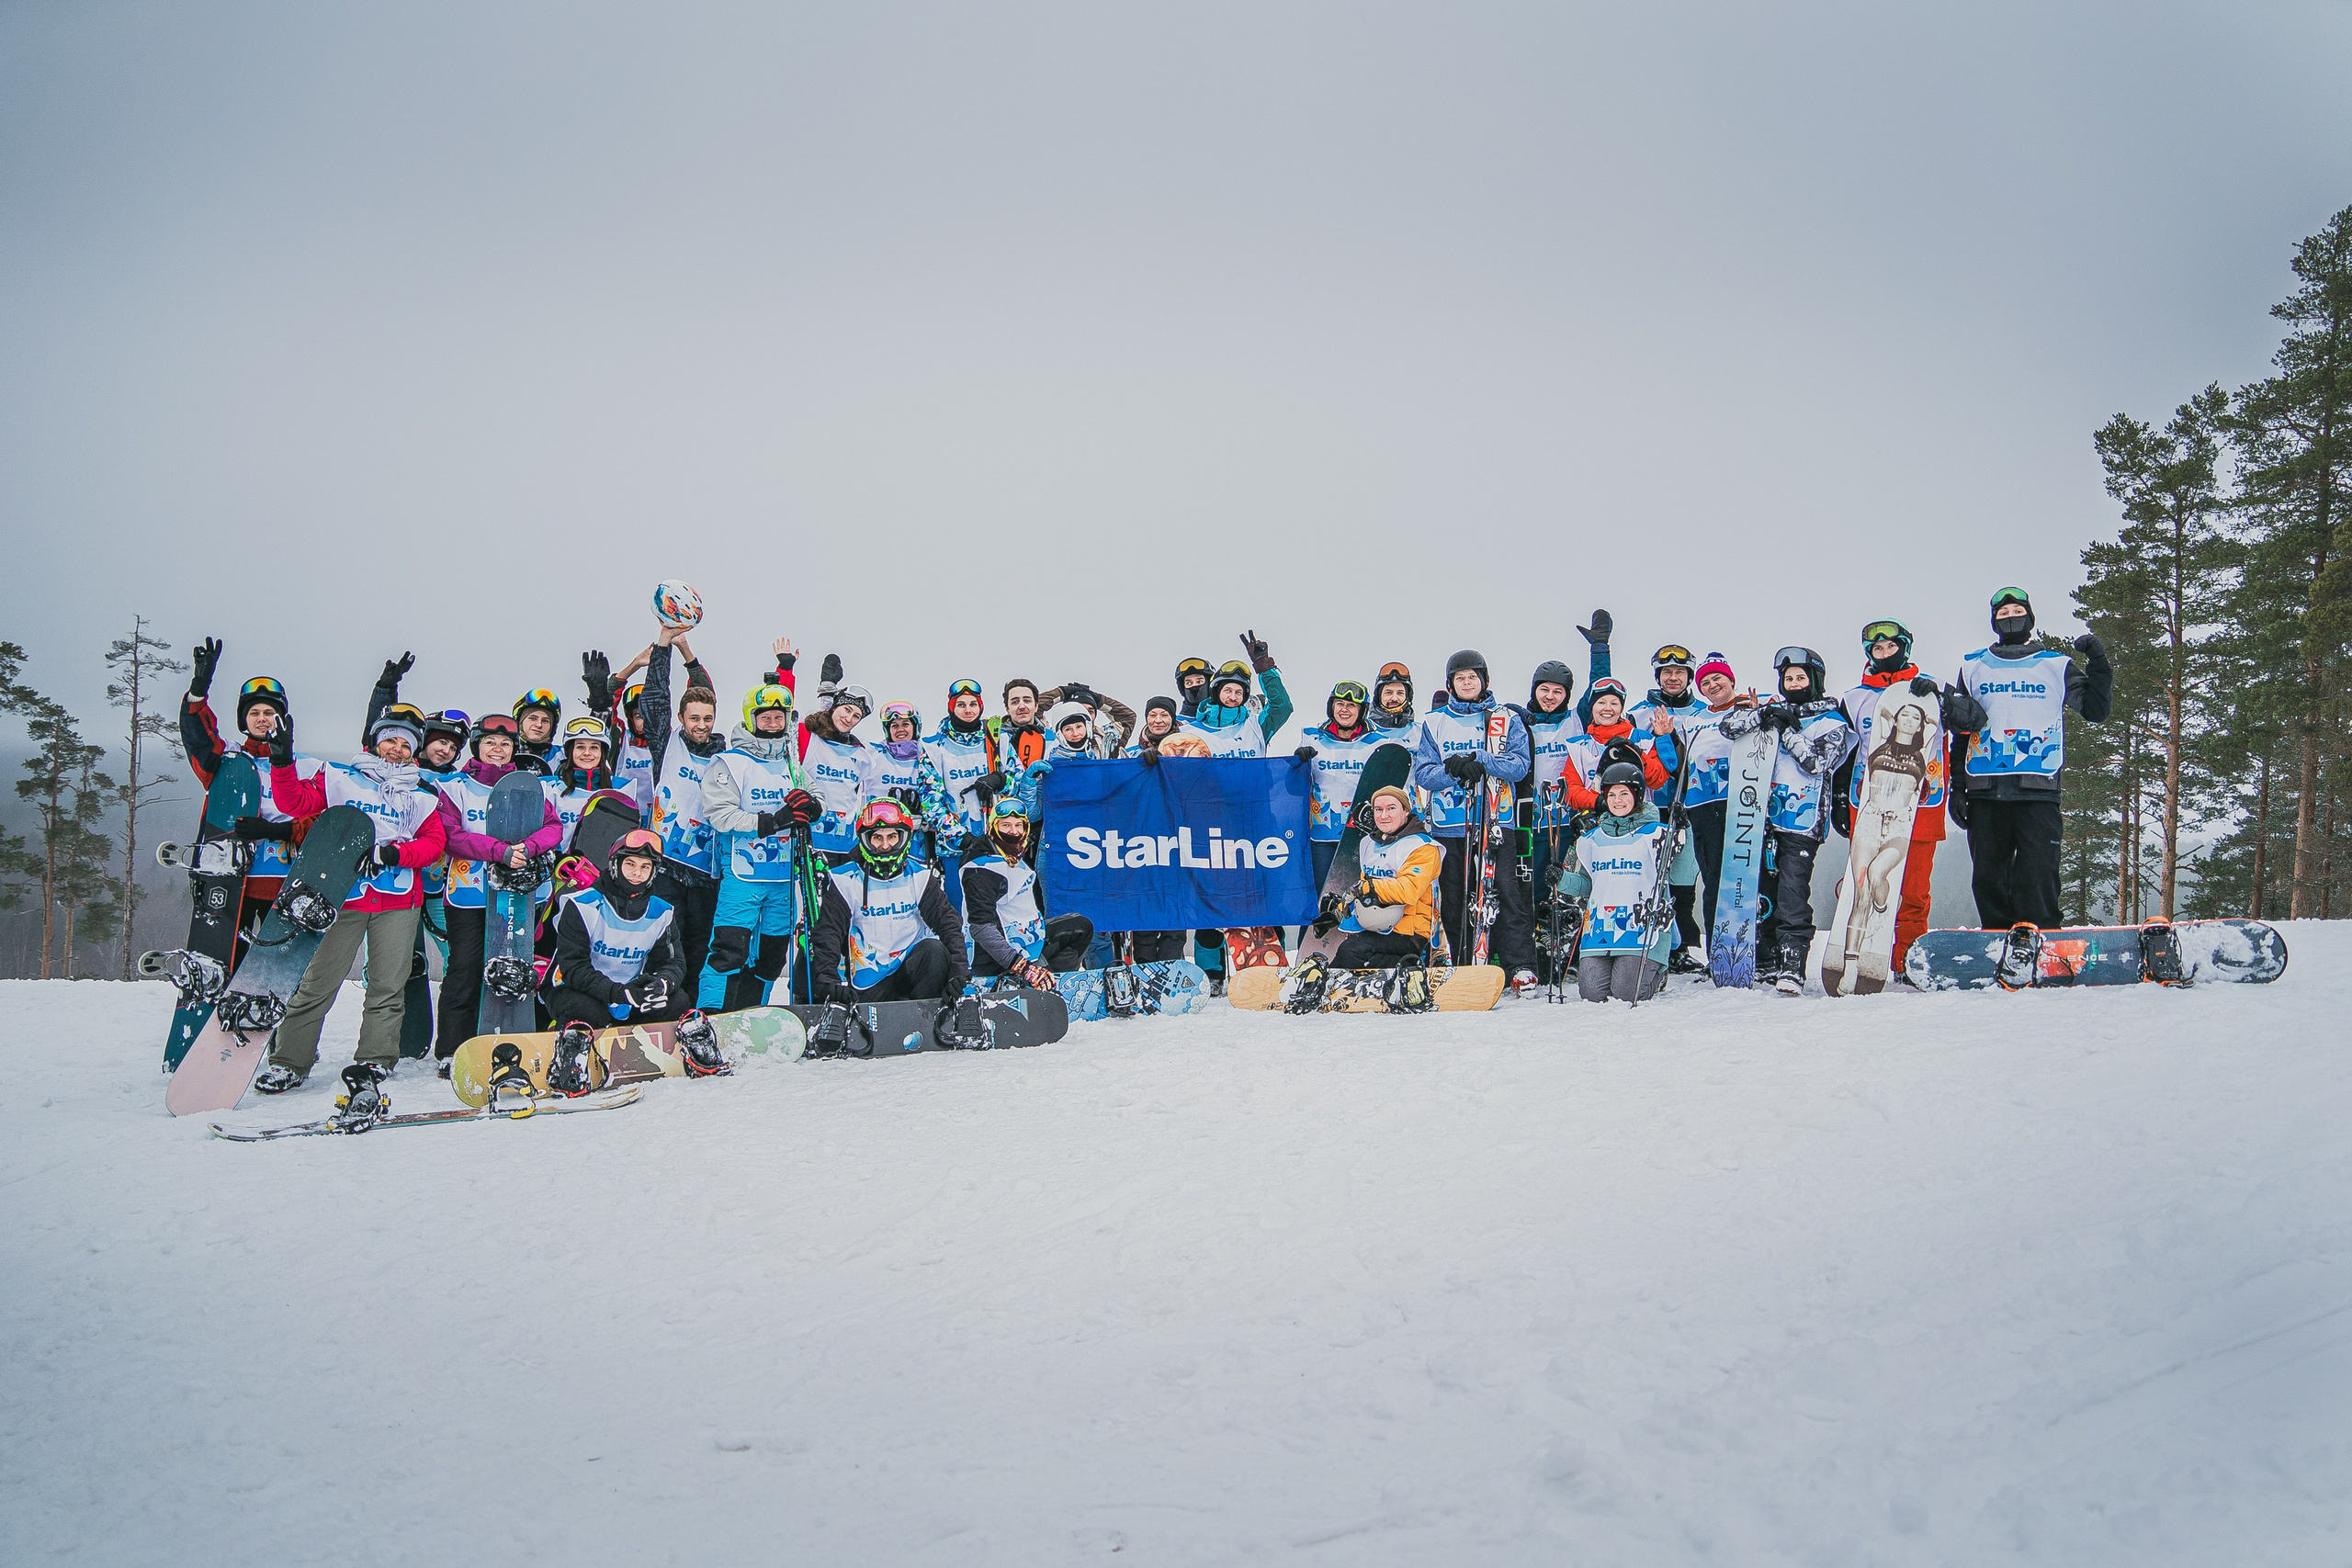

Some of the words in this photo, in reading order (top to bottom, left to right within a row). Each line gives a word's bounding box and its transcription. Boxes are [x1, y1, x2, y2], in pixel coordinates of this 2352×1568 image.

[1979, 681, 2046, 695] StarLine
[1687, 722, 1720, 734] StarL
[1442, 739, 1485, 752] StarLi
[1535, 742, 1566, 754] arLin
[1212, 749, 1256, 759] tarLine
[625, 758, 651, 770] Star
[1318, 760, 1364, 771] StarLin
[949, 764, 988, 780] StarLi
[882, 774, 919, 787] StarLi
[752, 788, 792, 801] StarL
[345, 800, 400, 818] StarLi
[1733, 769, 1758, 867] JOINT
[1066, 827, 1289, 869] StarLine
[1591, 858, 1643, 873] StarLine
[211, 892, 224, 905] 53
[1734, 876, 1744, 908] rental
